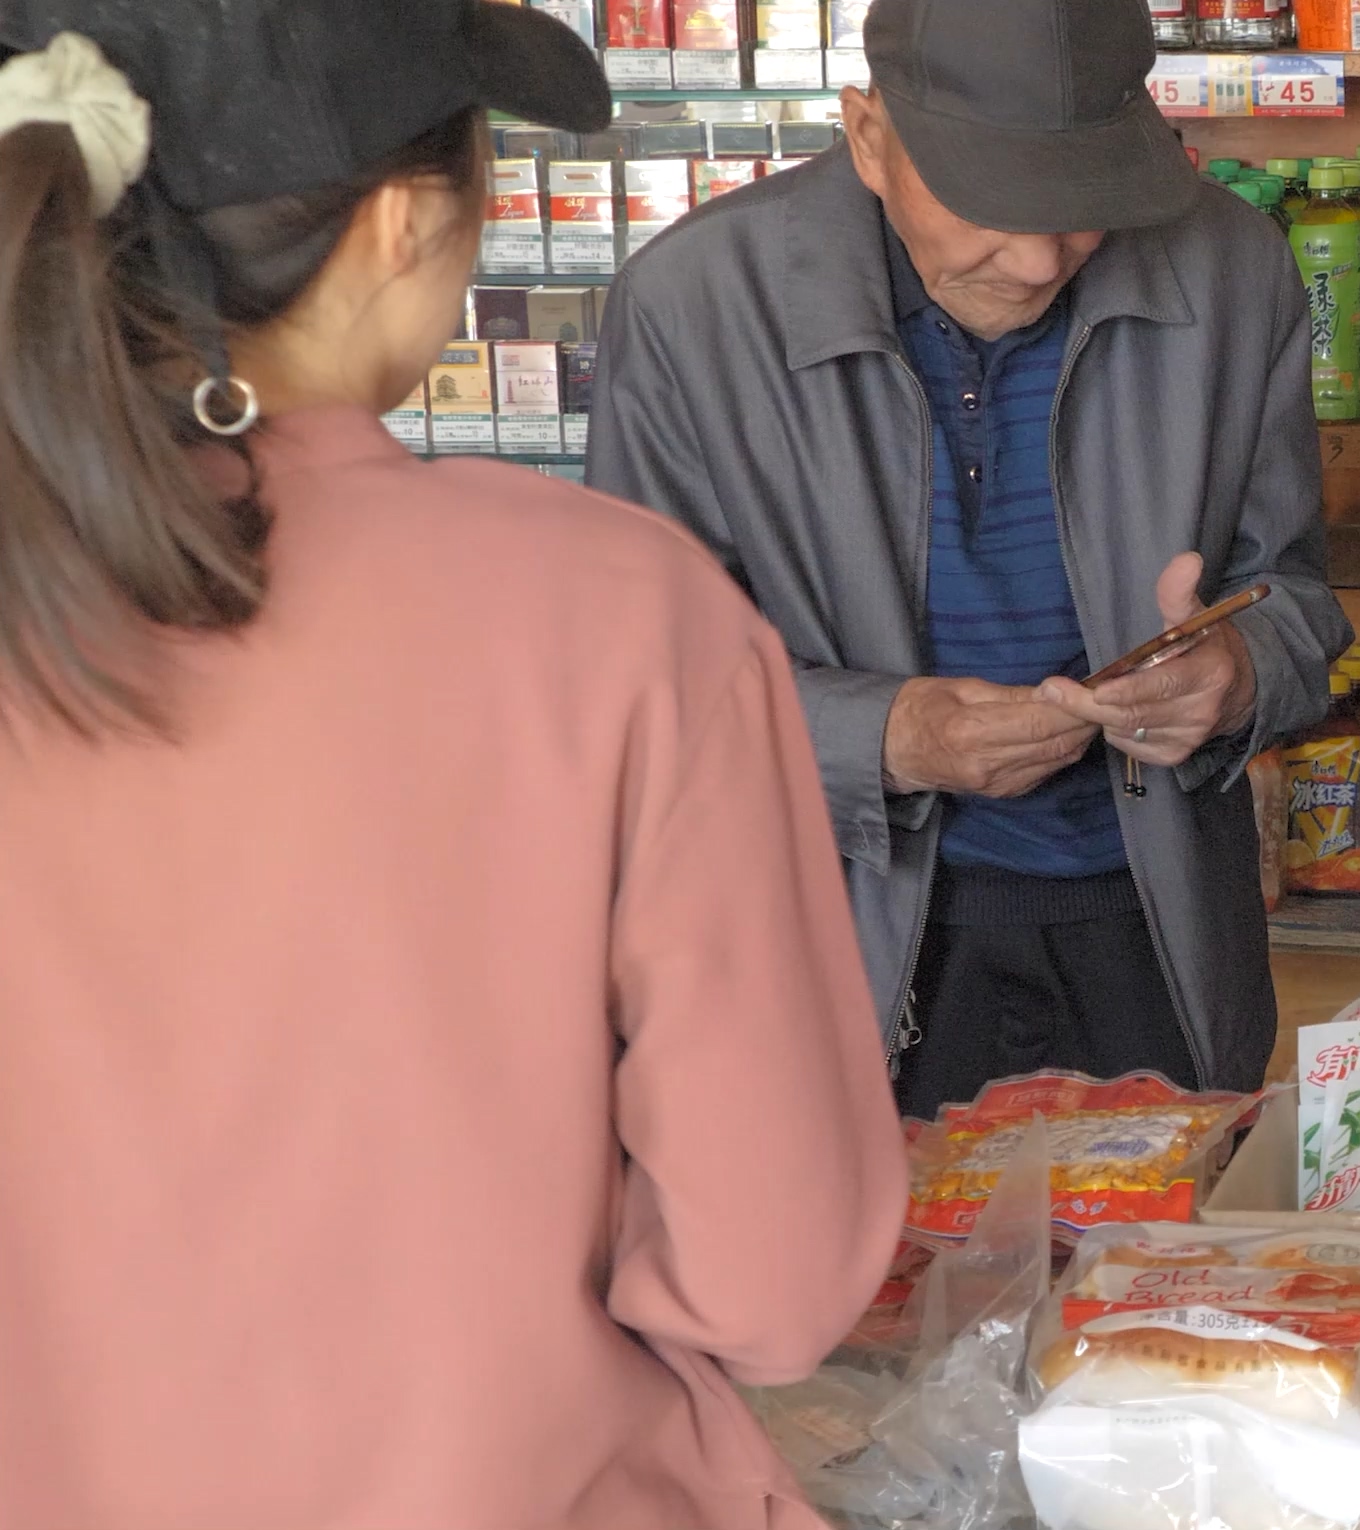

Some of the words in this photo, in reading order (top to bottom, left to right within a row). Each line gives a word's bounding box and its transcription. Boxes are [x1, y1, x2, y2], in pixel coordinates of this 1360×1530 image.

[1280, 80, 1316, 104] 45
[1289, 776, 1357, 812] 冰红茶
[1132, 1268, 1212, 1289] Old
[1125, 1285, 1254, 1304] Bread
